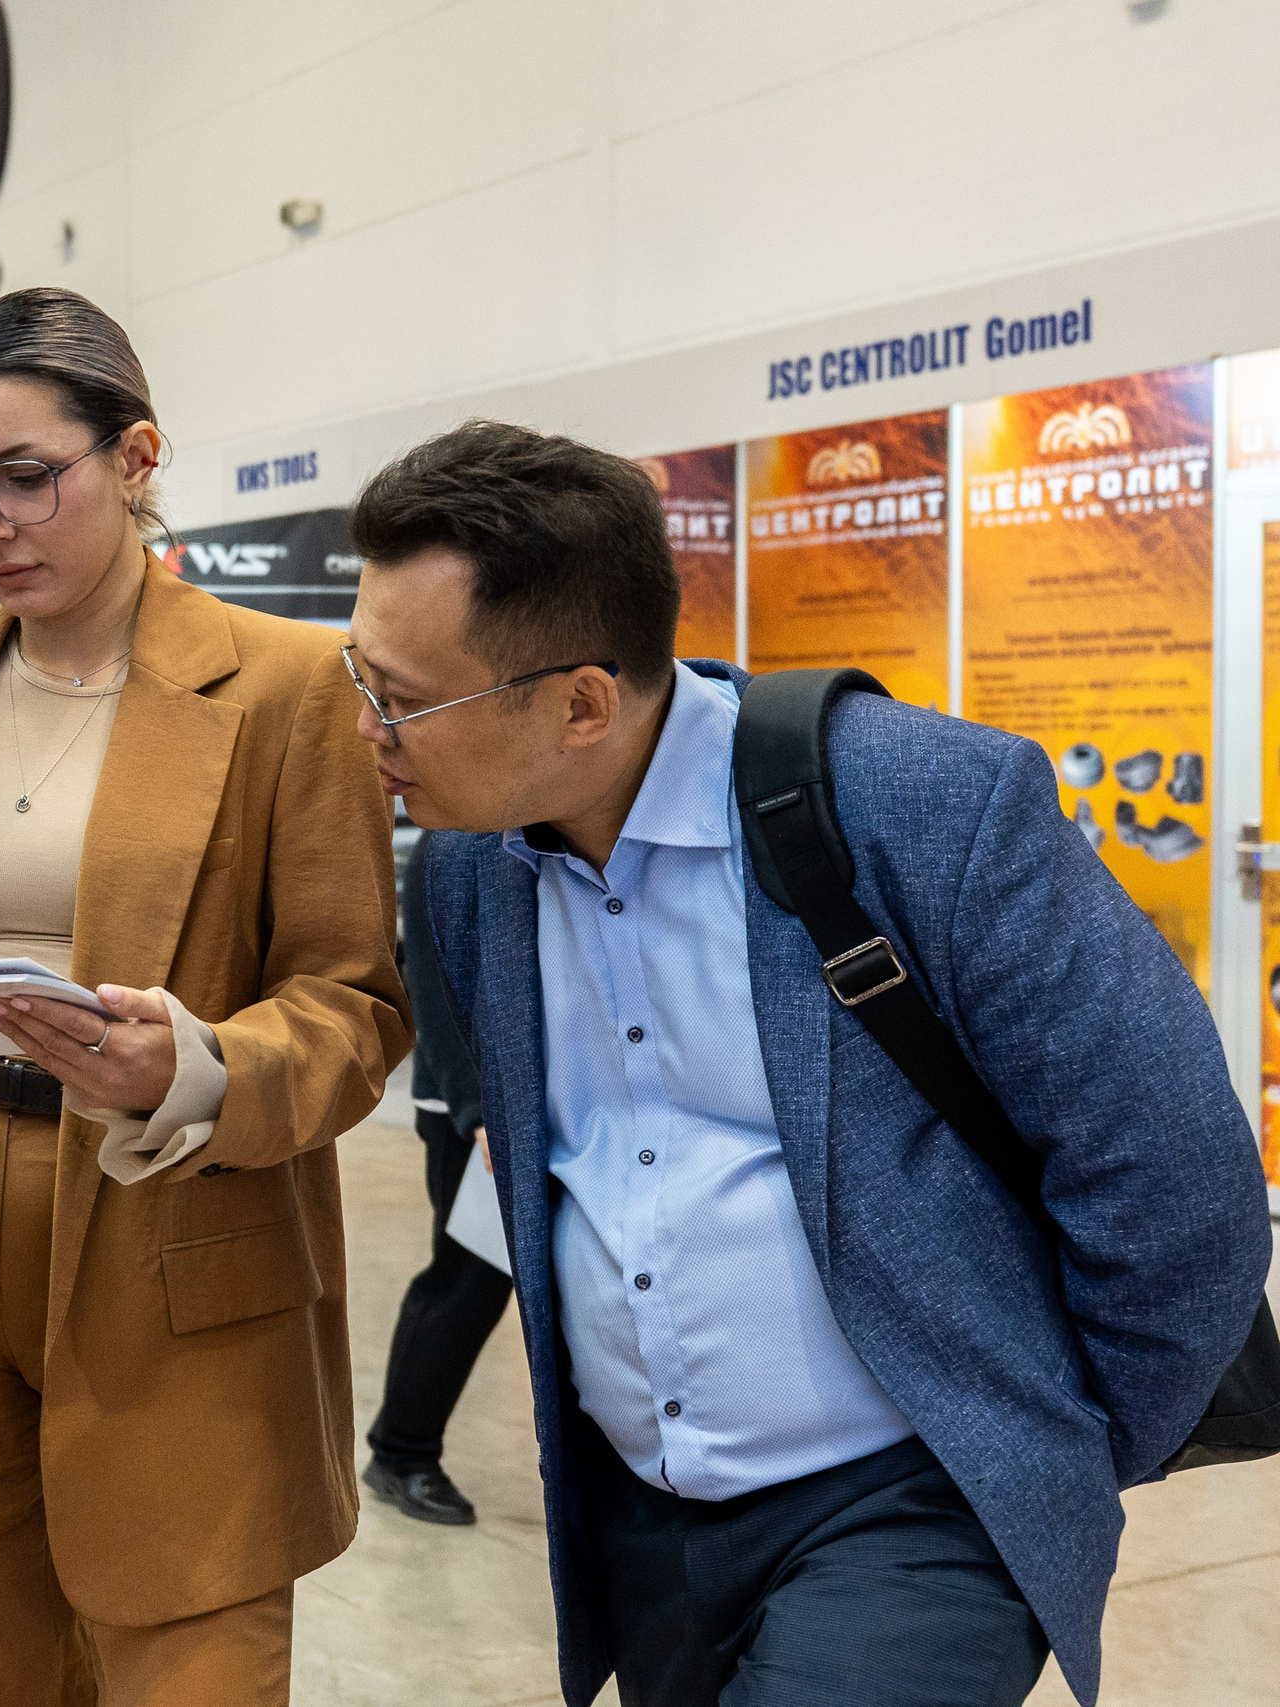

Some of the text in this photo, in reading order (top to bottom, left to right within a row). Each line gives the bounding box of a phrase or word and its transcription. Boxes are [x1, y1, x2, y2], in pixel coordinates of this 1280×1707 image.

[767, 297, 1093, 401] JSC CENTROLIT Gomel
[273, 450, 318, 487] TOOLS
[970, 458, 1209, 514] ЦЕНТРОЛИТ
[750, 490, 945, 538] ЦЕНТРОЛИТ
